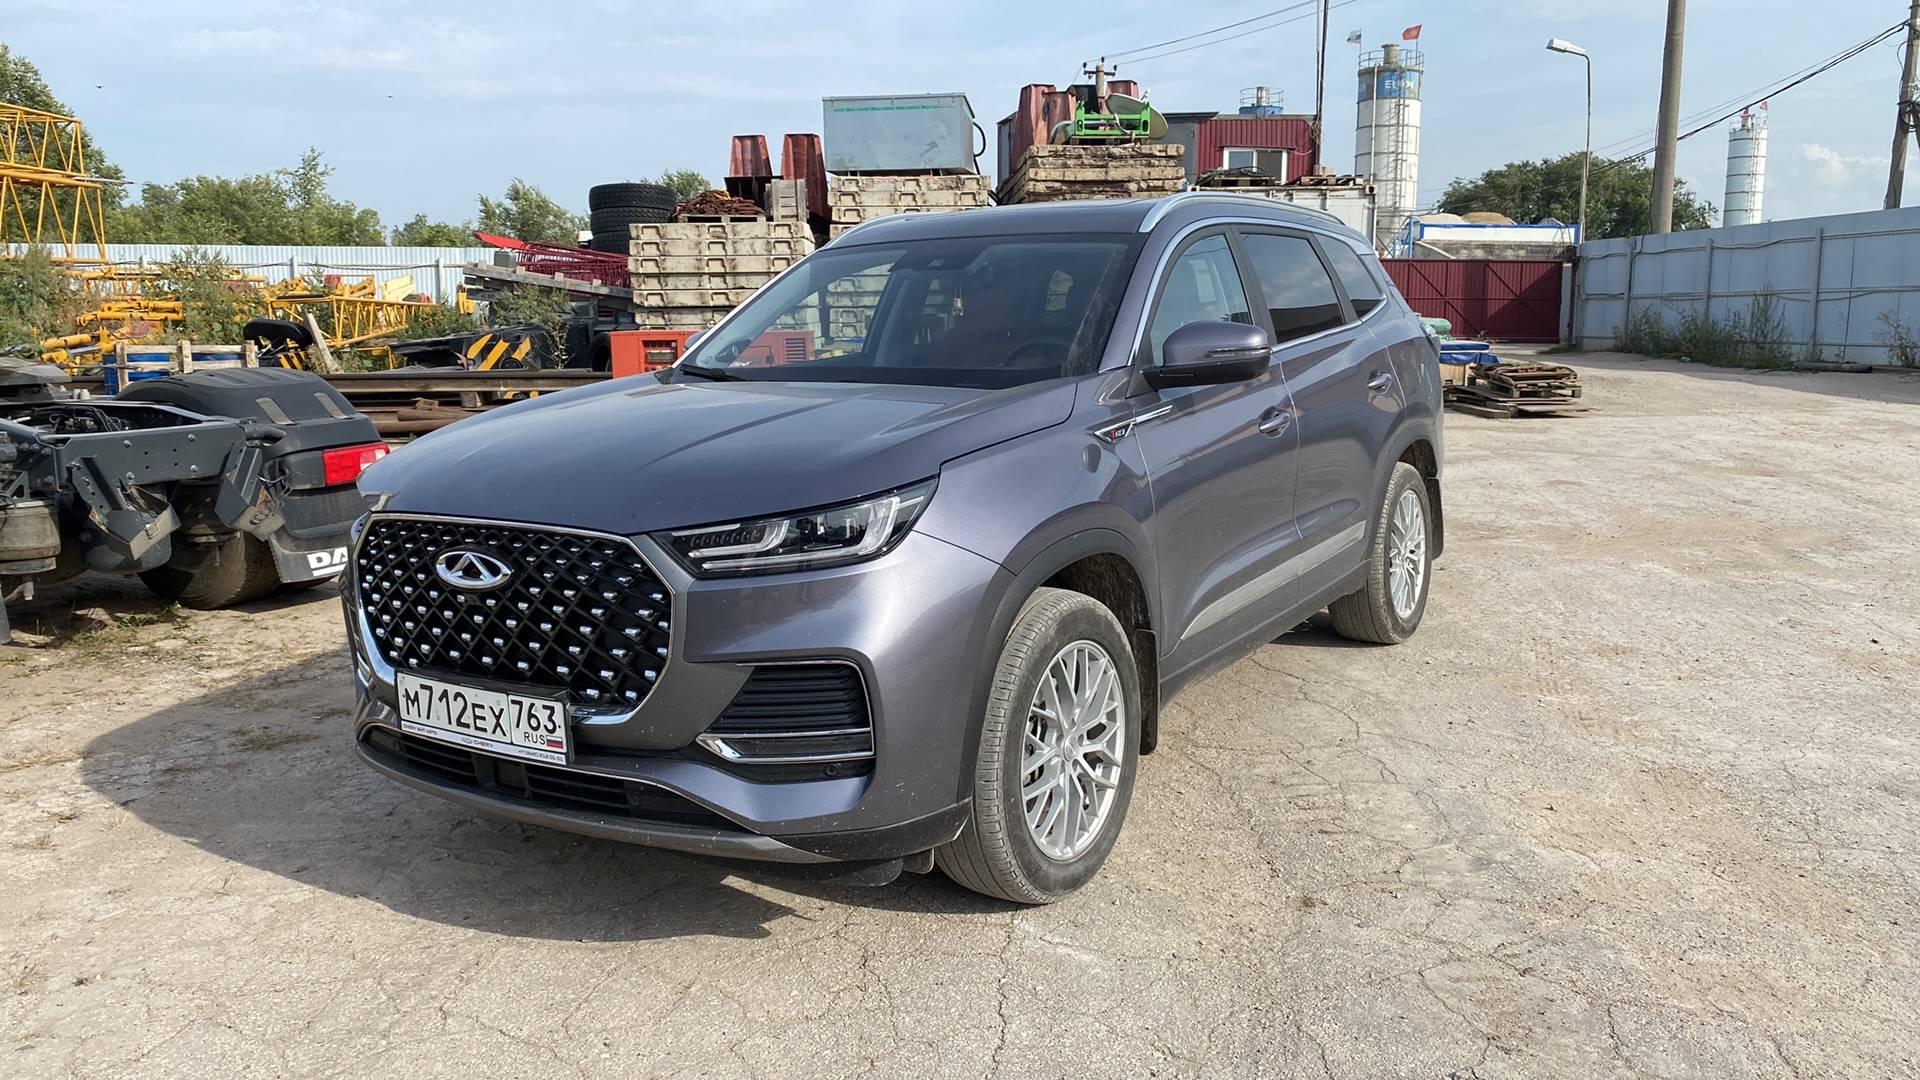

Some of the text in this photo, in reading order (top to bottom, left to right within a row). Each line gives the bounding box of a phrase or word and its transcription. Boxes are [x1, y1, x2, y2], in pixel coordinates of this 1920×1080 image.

[307, 546, 348, 569] DA
[404, 683, 557, 737] M712EX 763
[524, 731, 546, 745] RUS
